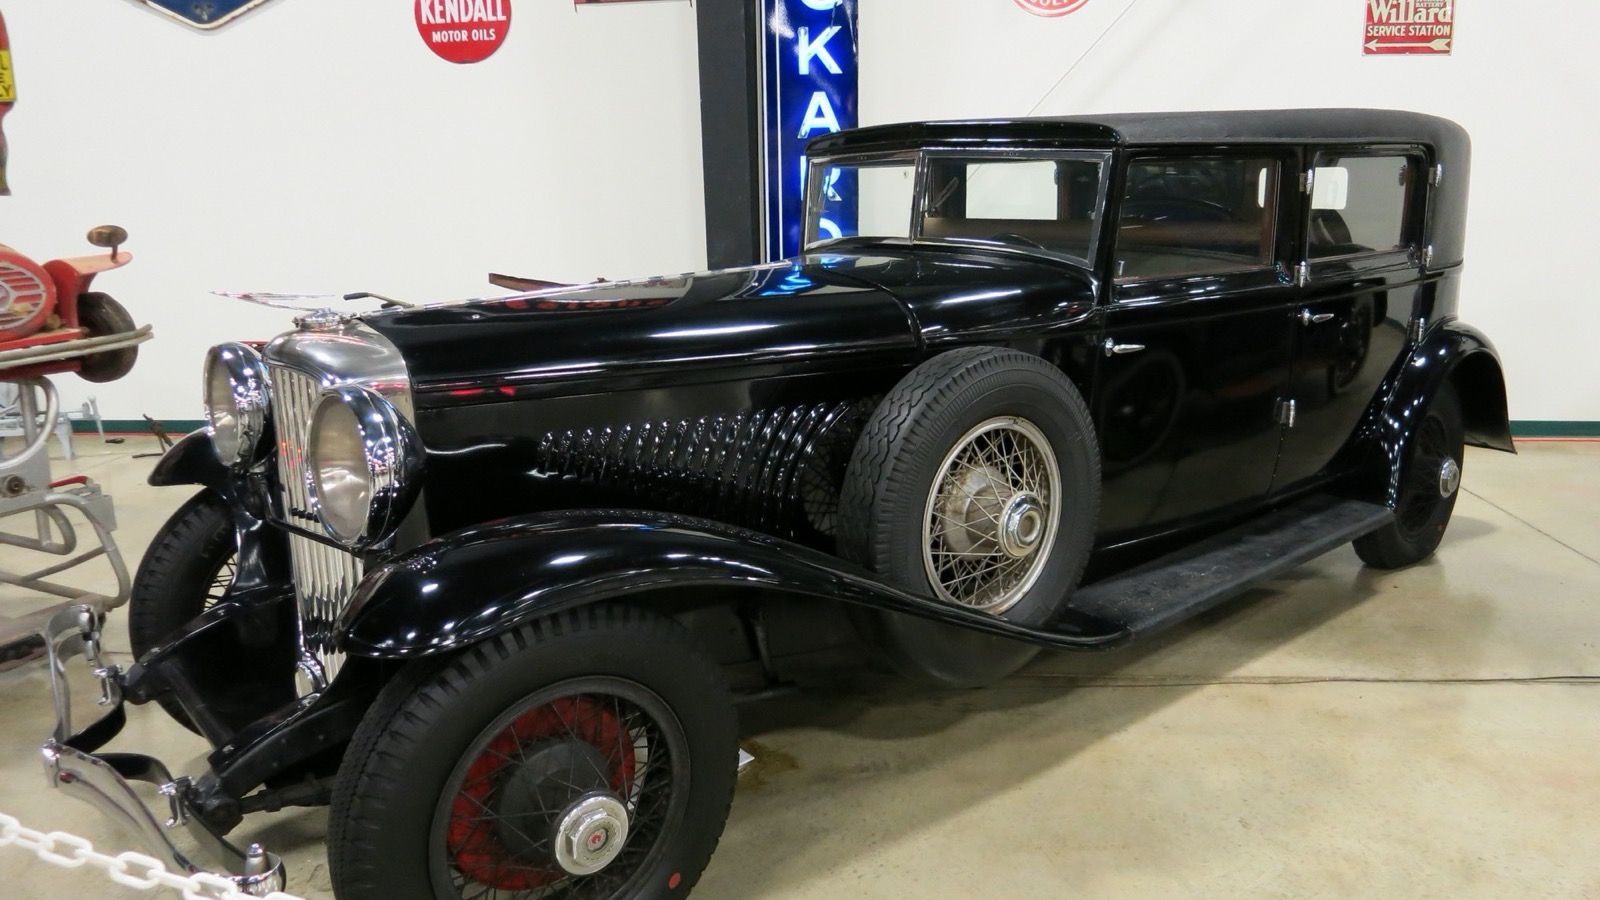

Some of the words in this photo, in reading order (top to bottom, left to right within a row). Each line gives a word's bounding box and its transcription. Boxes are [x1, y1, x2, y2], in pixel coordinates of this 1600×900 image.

[420, 0, 507, 24] KENDALL
[1366, 0, 1452, 23] Willard
[432, 29, 469, 43] MOTOR
[471, 28, 497, 41] OILS
[1366, 25, 1406, 37] SERVICE
[1408, 24, 1451, 37] STATION
